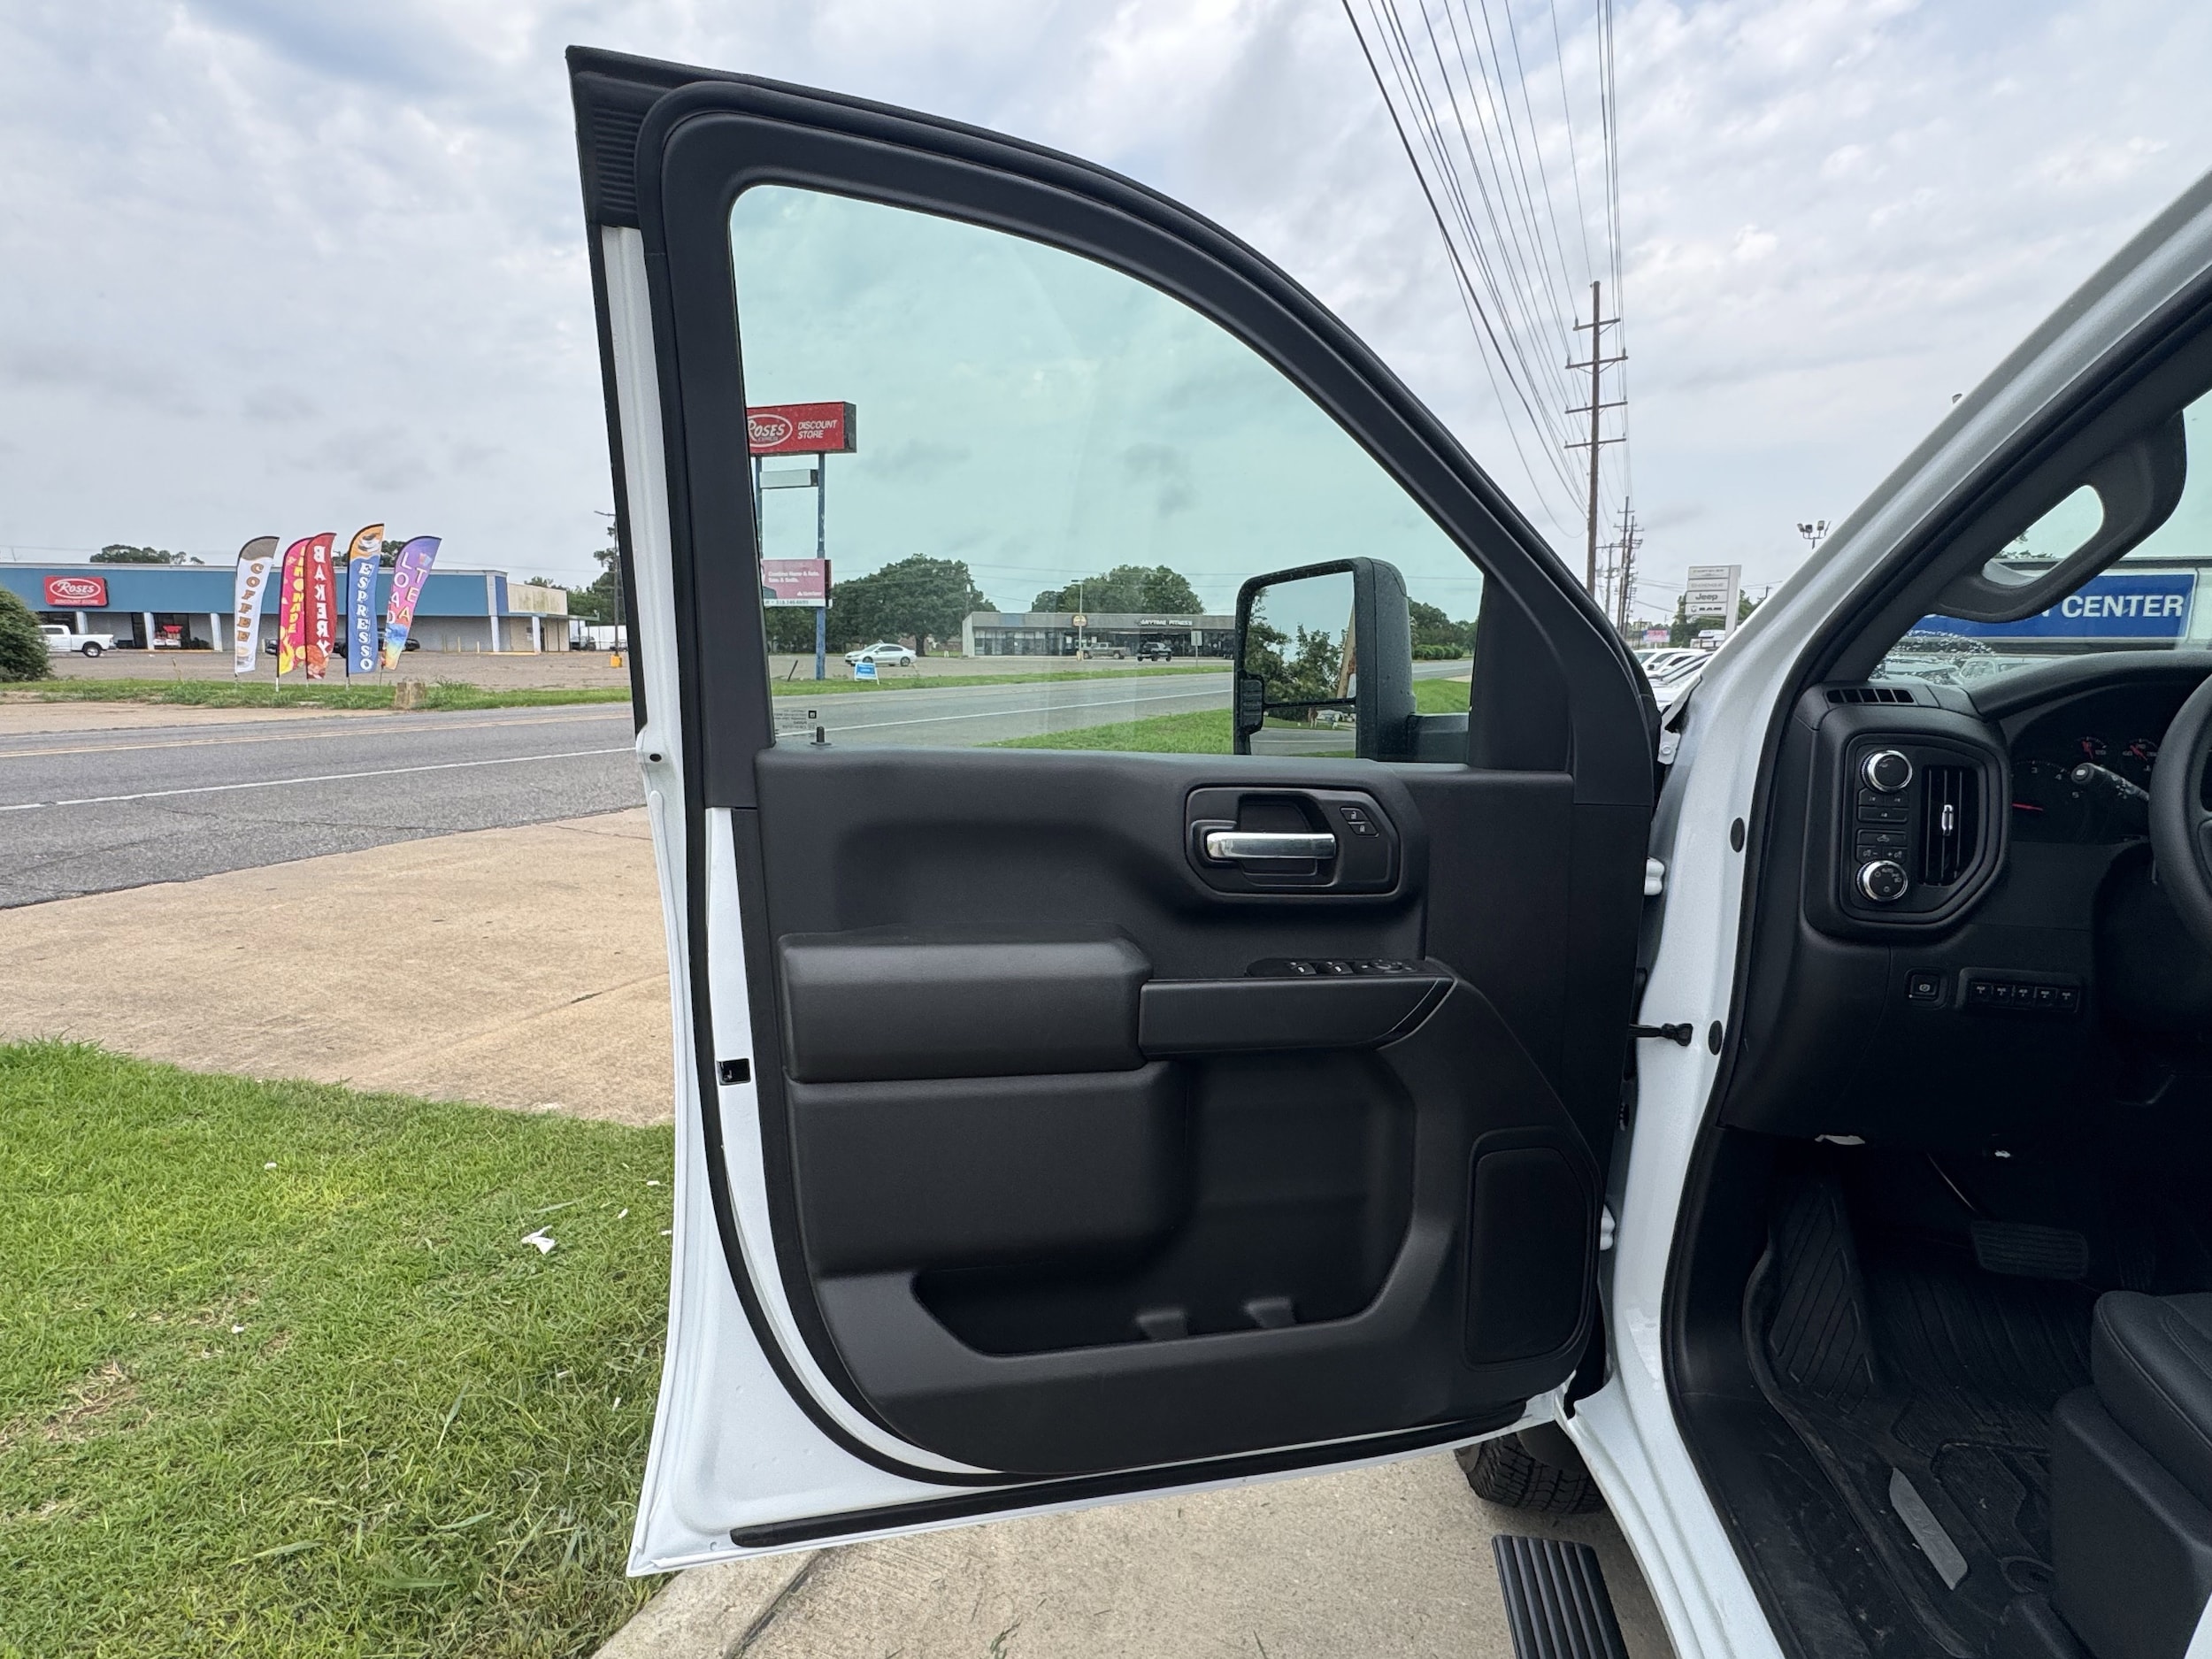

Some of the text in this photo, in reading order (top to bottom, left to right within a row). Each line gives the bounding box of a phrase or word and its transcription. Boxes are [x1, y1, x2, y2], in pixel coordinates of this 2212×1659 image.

[797, 419, 838, 431] DISCOUNT
[797, 430, 825, 440] STORE
[236, 563, 265, 642] COFFEE
[398, 567, 428, 623] TEA
[1694, 593, 1718, 602] Jeep
[2061, 594, 2185, 618] CENTER
[356, 562, 374, 671] ESPRESSO
